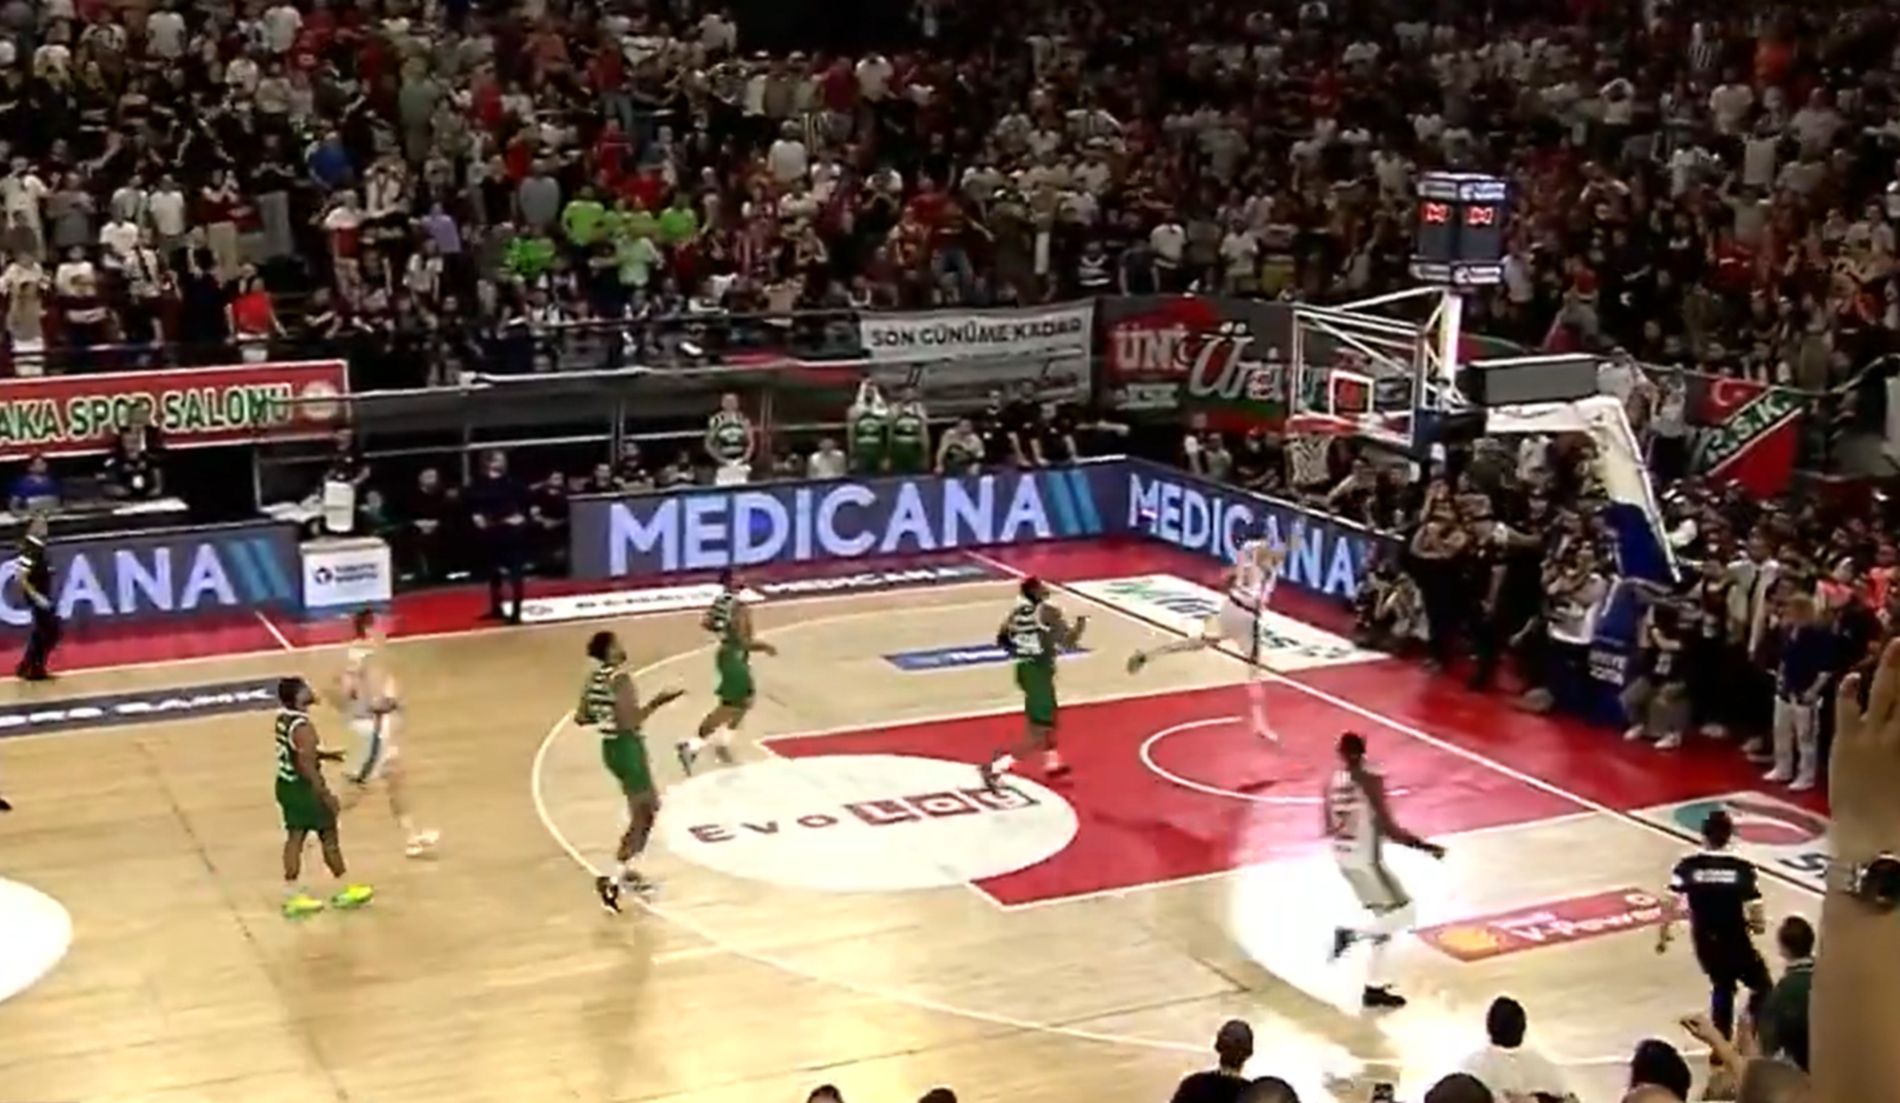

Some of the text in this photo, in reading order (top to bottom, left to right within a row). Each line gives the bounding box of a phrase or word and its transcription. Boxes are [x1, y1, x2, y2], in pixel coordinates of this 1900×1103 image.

[871, 328, 914, 347] SON
[610, 473, 1054, 577] MEDICANA
[1128, 472, 1357, 600] MEDICANA
